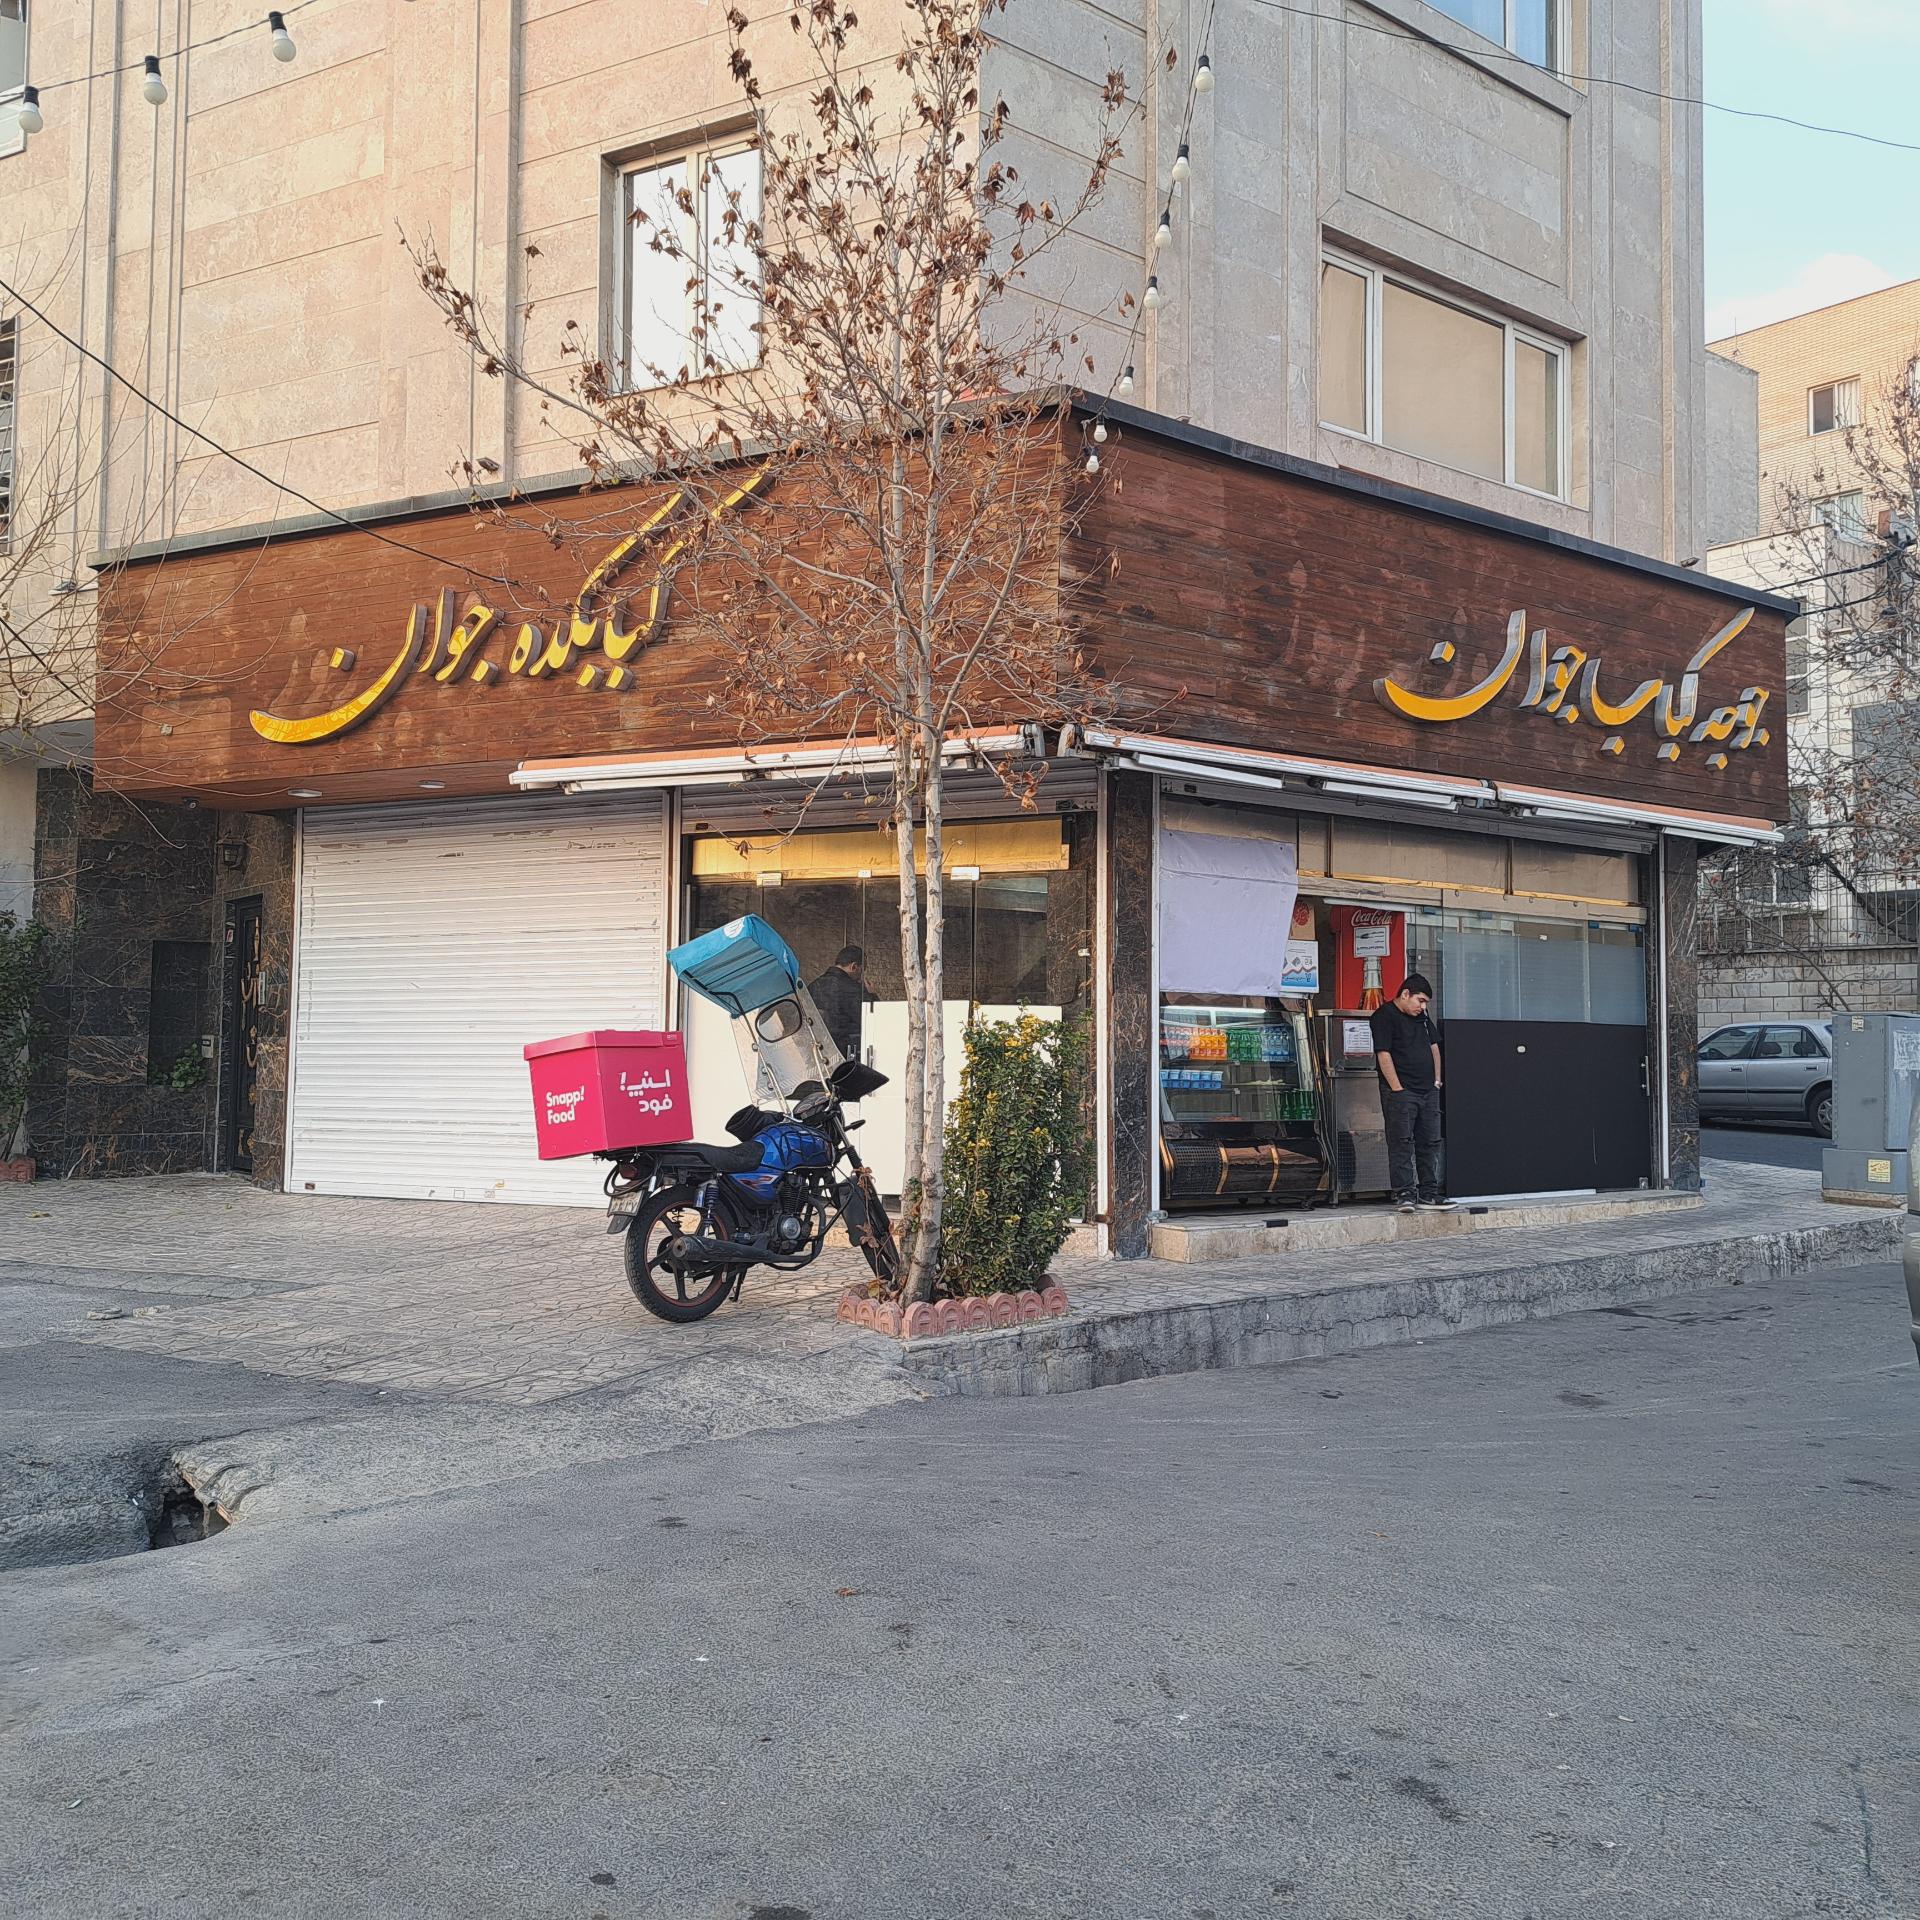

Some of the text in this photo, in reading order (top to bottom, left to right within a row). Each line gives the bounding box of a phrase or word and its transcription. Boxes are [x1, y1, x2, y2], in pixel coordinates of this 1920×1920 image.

[249, 586, 503, 743] جوان
[1373, 608, 1588, 725] جوان
[1580, 606, 1756, 763] کباب
[545, 1085, 585, 1108] Snapp!
[547, 1106, 576, 1126] Food
[638, 1094, 673, 1116] فود
